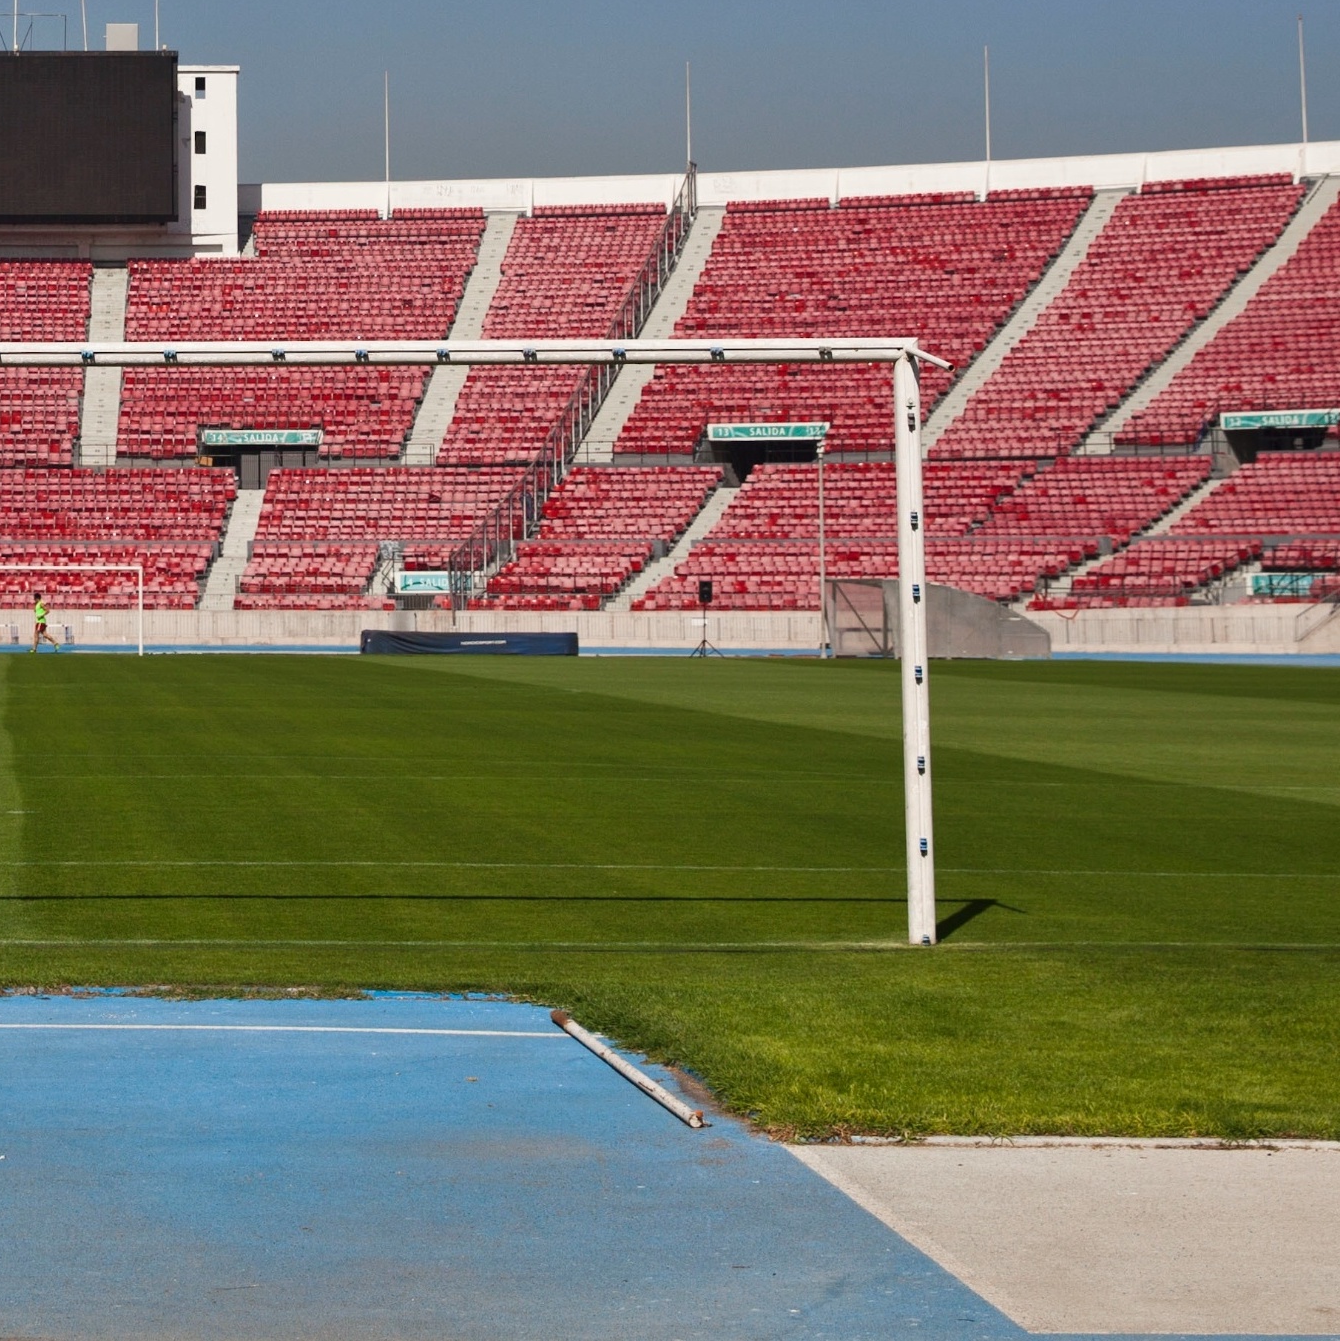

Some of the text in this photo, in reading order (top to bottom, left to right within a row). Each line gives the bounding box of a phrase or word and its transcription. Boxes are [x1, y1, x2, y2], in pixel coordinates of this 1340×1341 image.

[1261, 415, 1299, 427] SALIDA
[718, 428, 729, 437] 13
[749, 426, 786, 437] SALIDA
[212, 433, 223, 442] 14
[243, 433, 279, 442] SALIDA
[407, 578, 449, 587] 4 SALID
